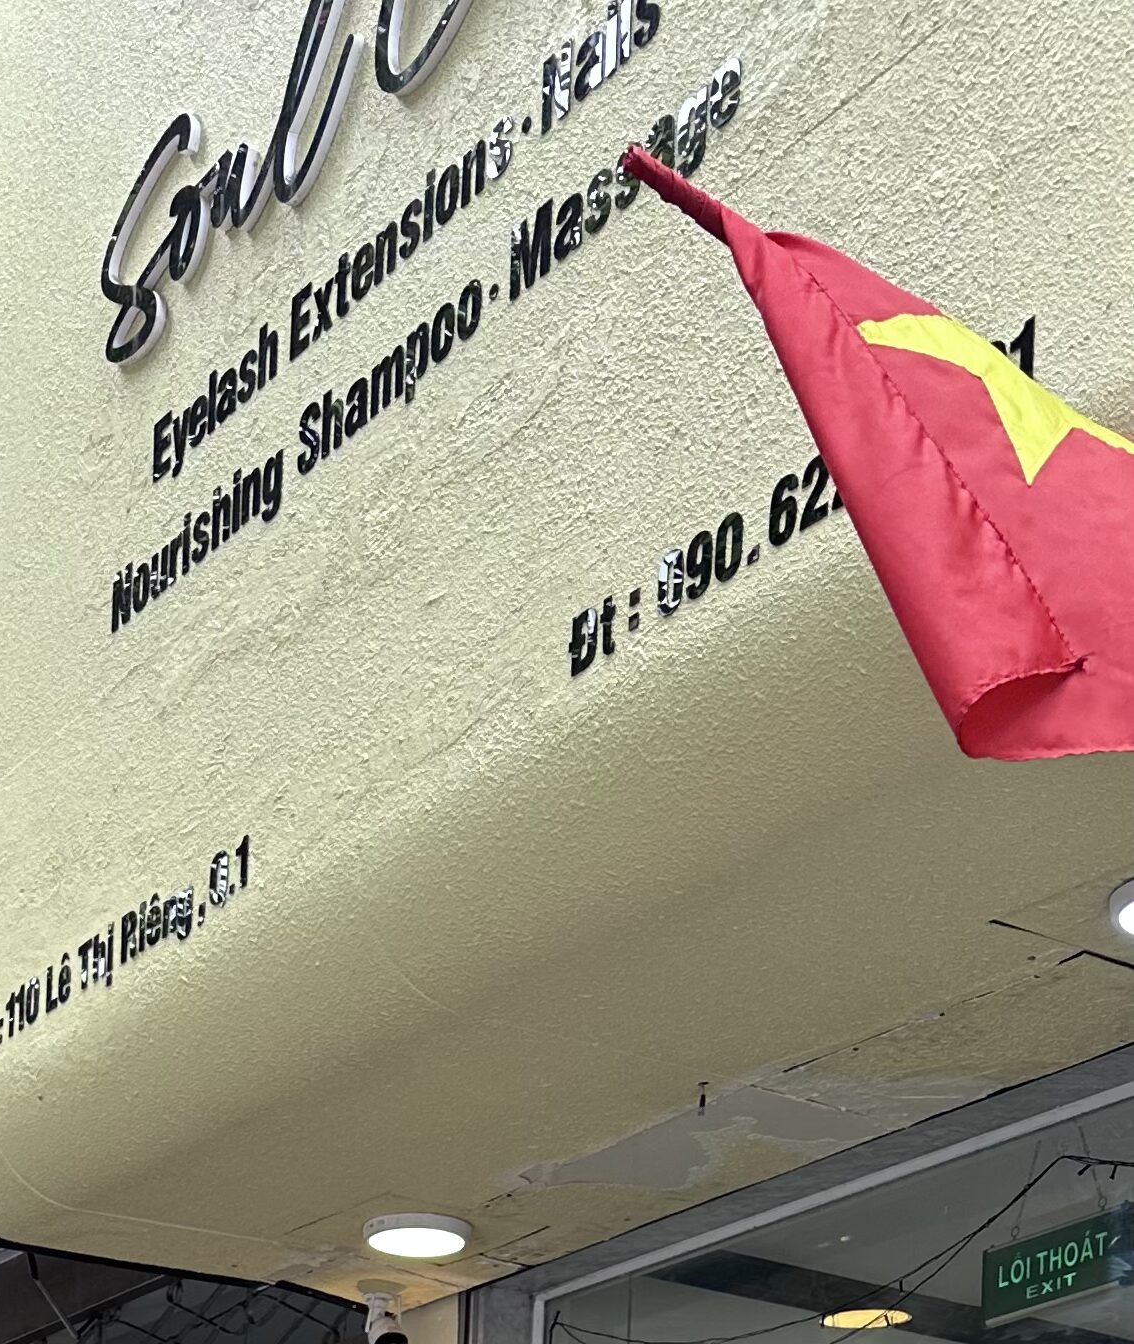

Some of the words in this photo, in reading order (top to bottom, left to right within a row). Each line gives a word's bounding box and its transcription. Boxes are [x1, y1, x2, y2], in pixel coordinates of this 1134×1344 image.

[153, 322, 279, 483] Eyelash
[290, 116, 512, 361] Extensions
[541, 0, 660, 135] Nails
[112, 449, 284, 633] Nourishing
[297, 279, 481, 476] Shampoo
[510, 58, 742, 301] Massage
[657, 454, 844, 617] 090.62
[46, 952, 71, 1013] Lê
[78, 921, 115, 990] Thị
[1026, 1272, 1077, 1299] EXIT
[1036, 1230, 1108, 1275] THOÁT
